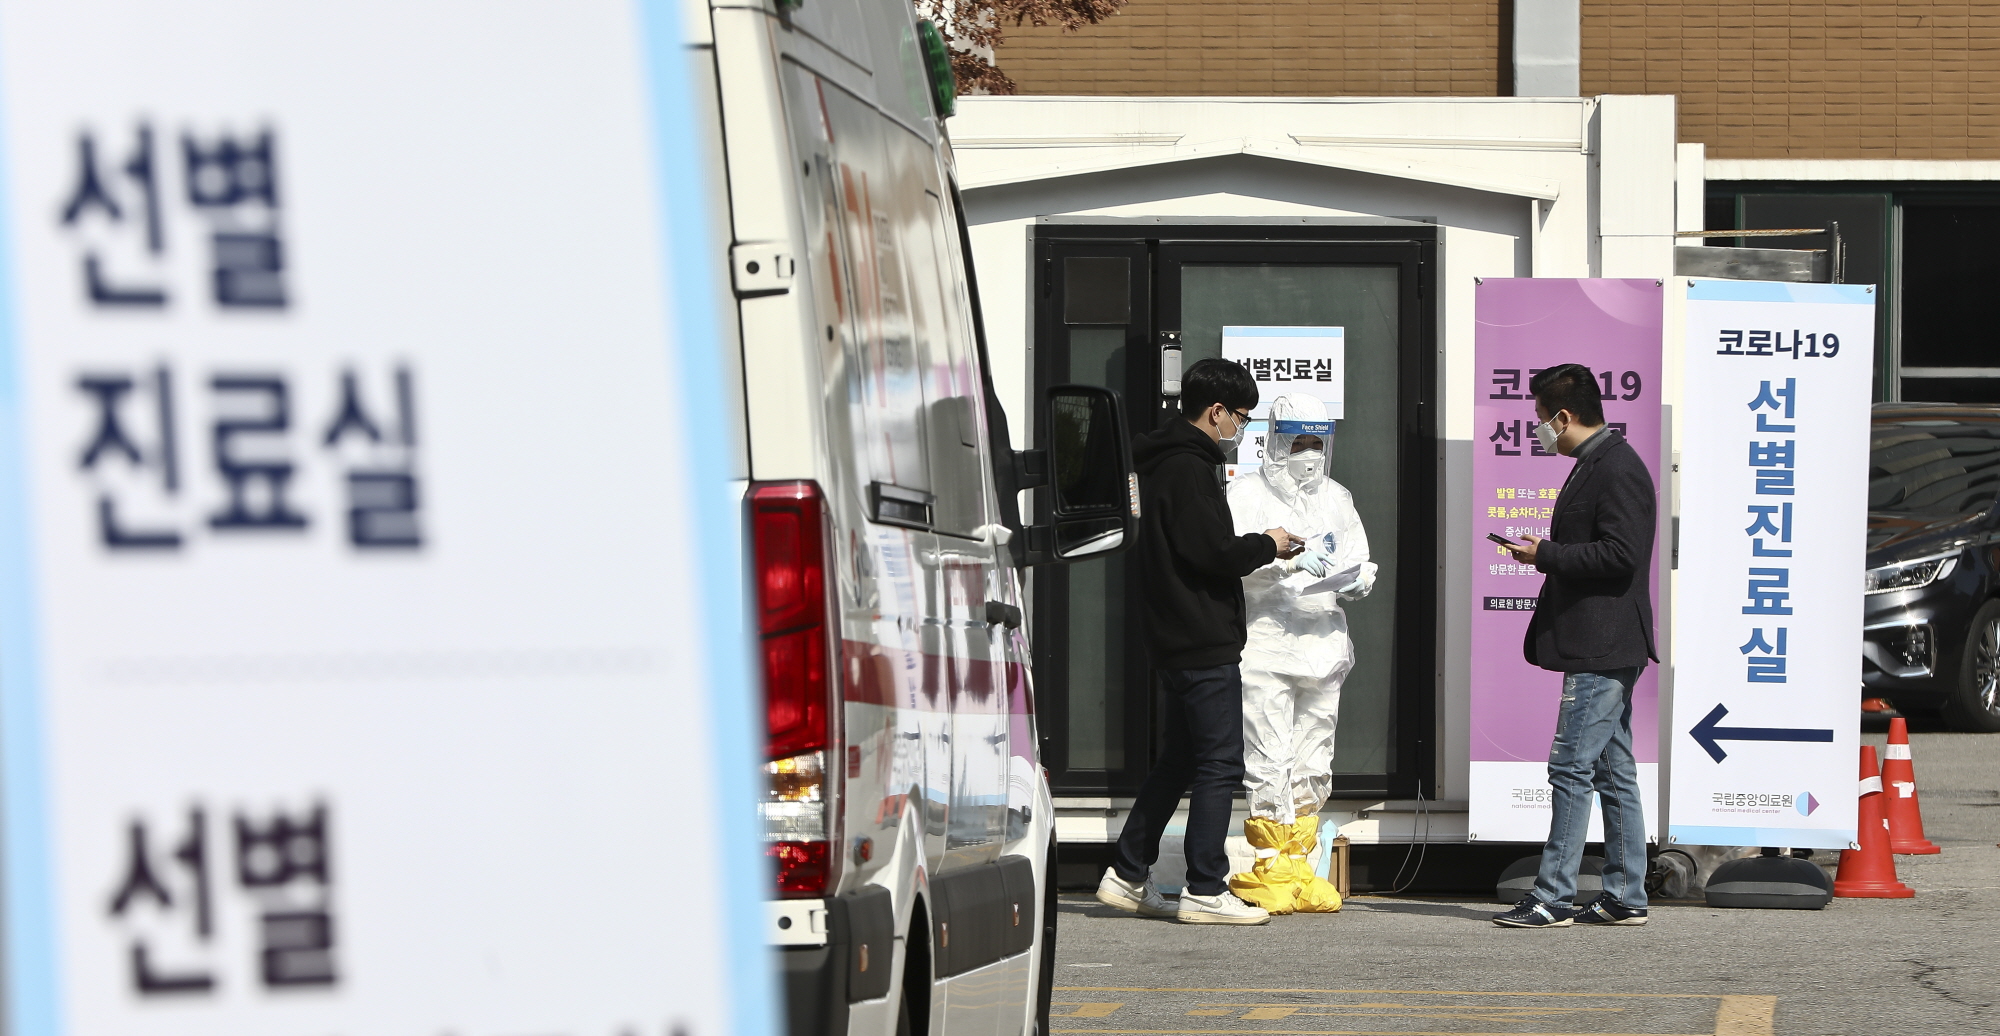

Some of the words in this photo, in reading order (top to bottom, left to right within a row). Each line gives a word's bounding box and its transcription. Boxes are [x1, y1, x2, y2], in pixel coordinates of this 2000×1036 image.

[58, 120, 292, 312] 선별
[1716, 329, 1840, 359] 코로나19
[1489, 367, 1642, 401] 코19
[71, 360, 427, 553] 진료실
[1496, 488, 1515, 499] 발열
[1517, 488, 1536, 499] 또는
[1505, 526, 1532, 537] 증상이
[1739, 377, 1796, 683] 선별진료실
[1490, 564, 1516, 575] 방문한
[1518, 564, 1536, 575] 분은
[1490, 598, 1514, 609] 의료원
[1712, 792, 1793, 808] 국립중앙의료원
[105, 797, 341, 996] 선별
